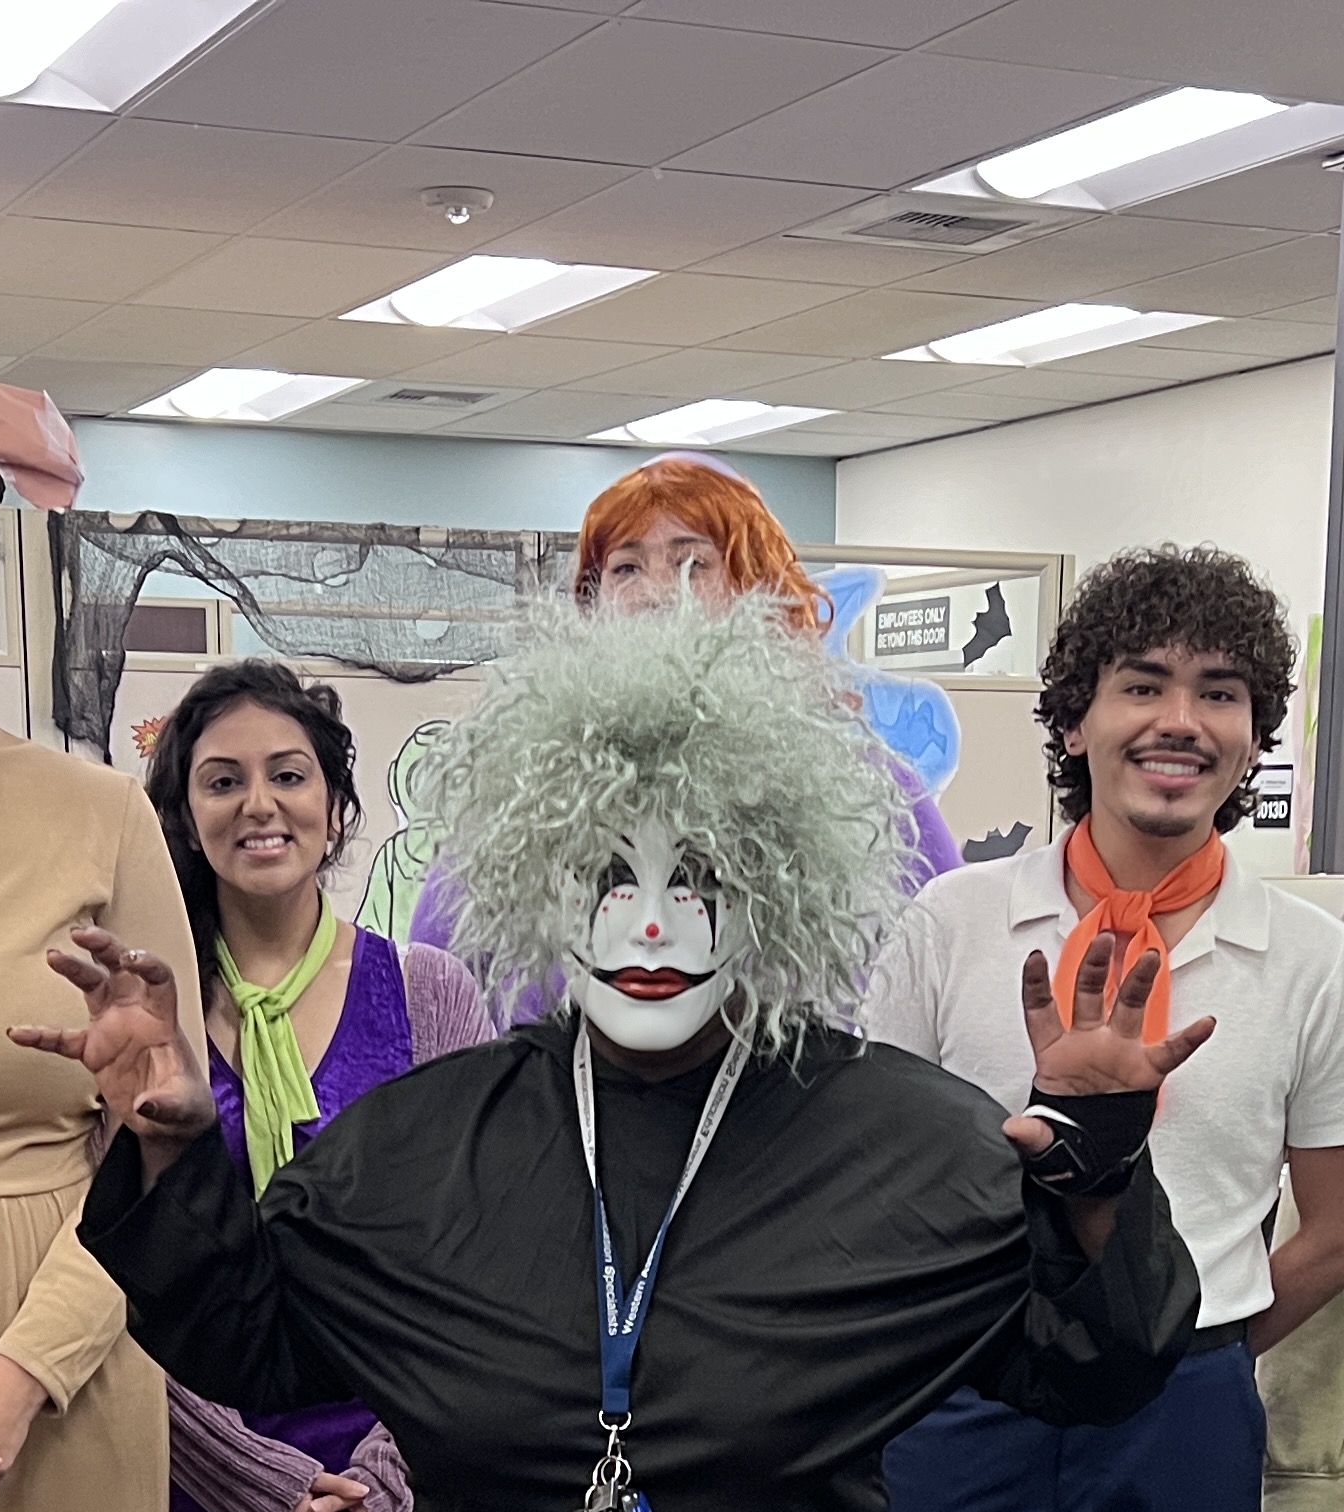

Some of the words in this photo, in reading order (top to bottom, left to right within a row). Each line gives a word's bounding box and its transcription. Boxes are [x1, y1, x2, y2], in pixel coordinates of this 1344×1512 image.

[879, 609, 923, 629] EMPLOYEES
[925, 606, 945, 624] ONLY
[878, 631, 906, 649] BEYOND
[907, 629, 922, 646] THIS
[923, 627, 945, 645] DOOR
[1256, 800, 1288, 820] 013D
[603, 1265, 619, 1336] Specialists
[621, 1280, 646, 1335] Western
